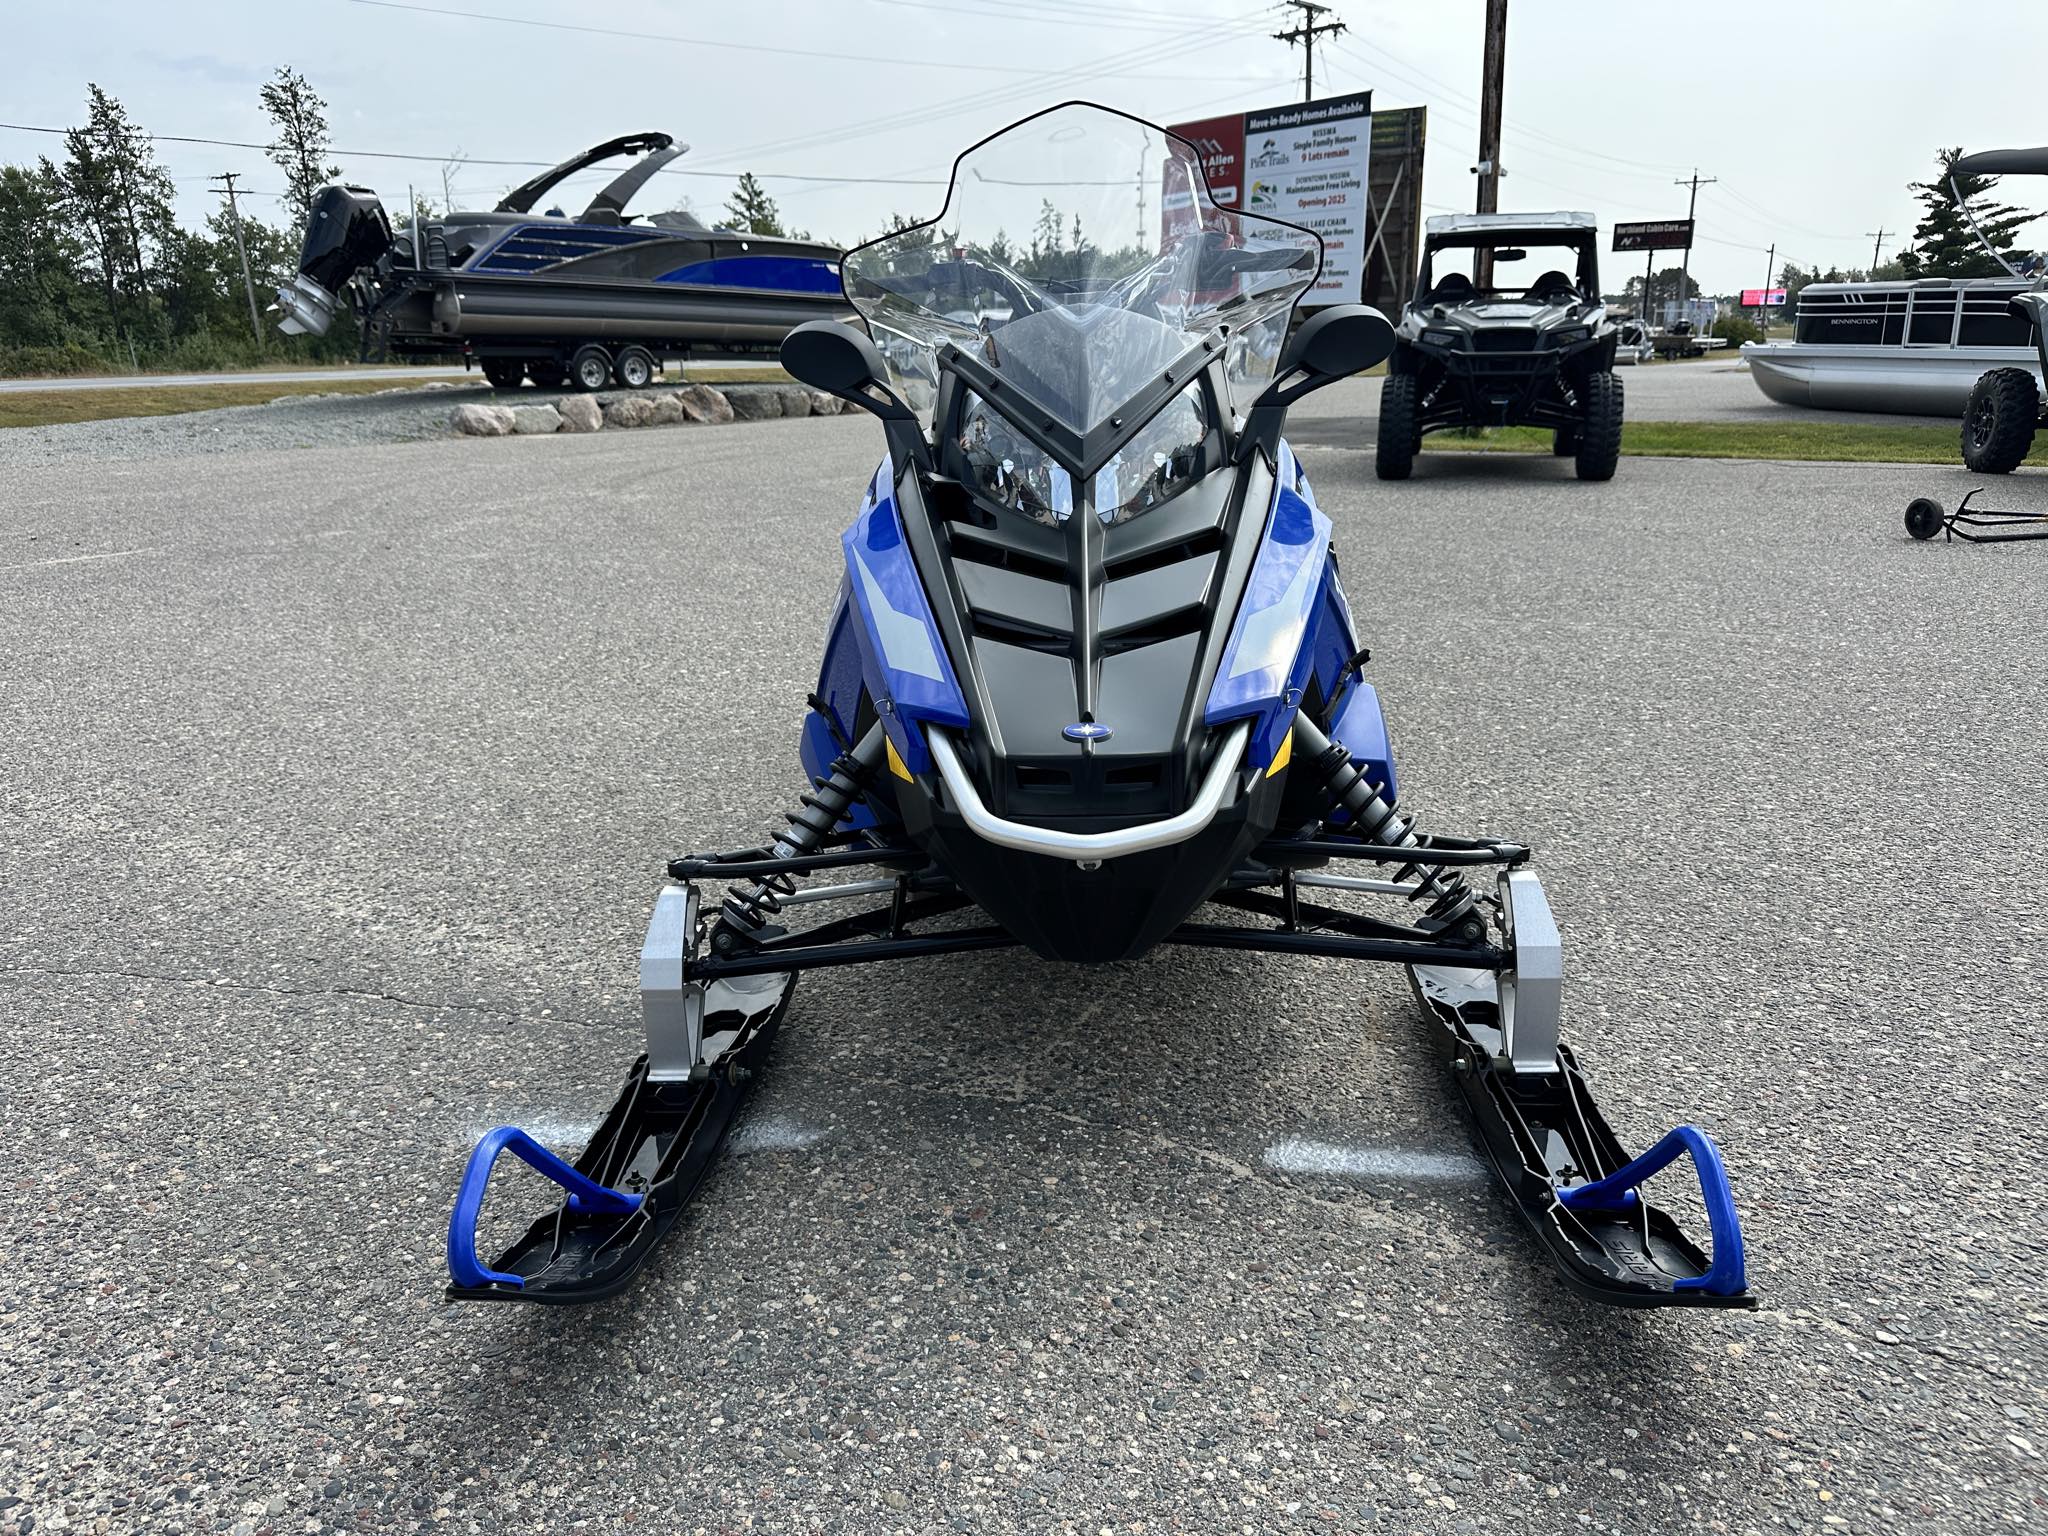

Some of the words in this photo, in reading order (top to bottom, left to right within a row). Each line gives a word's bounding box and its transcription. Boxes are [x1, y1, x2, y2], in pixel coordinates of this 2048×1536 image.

[1249, 112, 1301, 129] Move-in-Ready
[1302, 108, 1327, 120] Homes
[1328, 102, 1364, 117] Available
[1293, 140, 1311, 151] Single
[1312, 137, 1334, 148] Family
[1335, 135, 1356, 145] Homes
[1208, 154, 1234, 167] Allen
[1250, 157, 1267, 169] Pine
[1268, 153, 1289, 167] Trails
[1301, 153, 1308, 163] 9
[1308, 151, 1323, 161] Lots
[1323, 148, 1350, 159] remain
[1295, 173, 1328, 184] DOWNTOWN
[1286, 182, 1325, 194] Maintenance
[1325, 181, 1340, 191] Free
[1340, 179, 1360, 189] Living
[1298, 197, 1327, 208] Opening
[1328, 194, 1346, 205] 2025
[1310, 217, 1325, 228] LAKE
[1327, 217, 1347, 227] CHAIN
[1333, 227, 1354, 236] Homes
[1328, 269, 1349, 278] Homes
